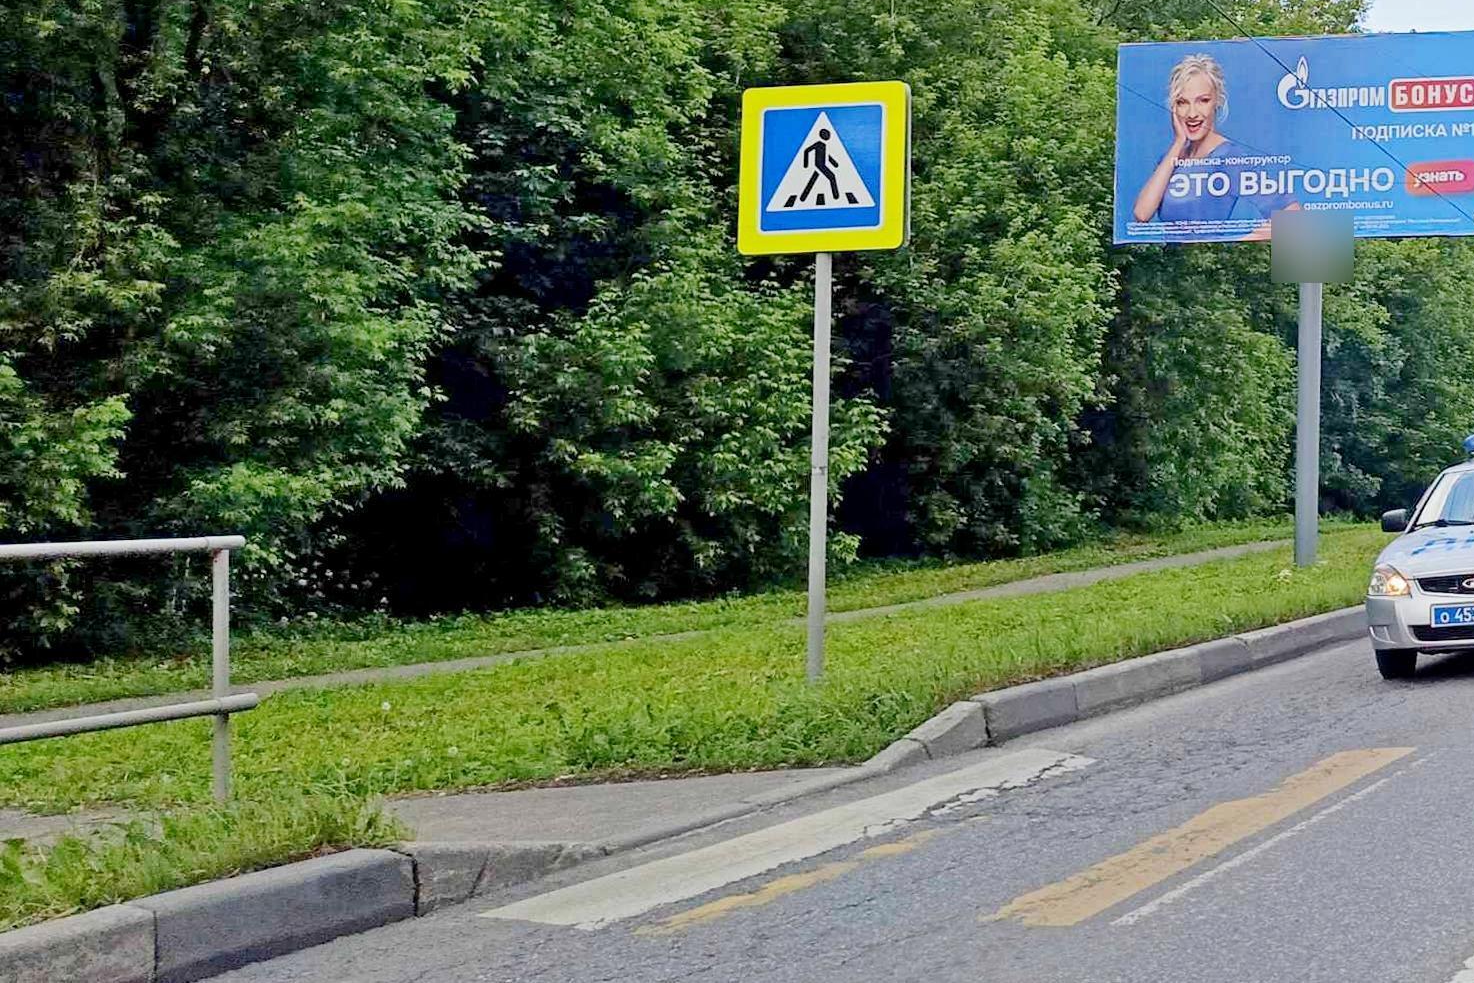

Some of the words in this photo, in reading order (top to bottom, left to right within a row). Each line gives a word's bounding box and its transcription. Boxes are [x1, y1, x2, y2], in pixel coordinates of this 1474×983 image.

[1309, 85, 1385, 109] ГАЗПРОМ
[1394, 83, 1474, 106] БОНУС
[1351, 124, 1448, 141] ПОДПИСКА
[1170, 154, 1292, 168] Подписка-конструктор
[1169, 171, 1231, 198] ЭТО
[1239, 167, 1396, 199] ВЫГОДНО
[1413, 169, 1466, 189] узнать
[1303, 199, 1395, 212] gazprombonus.ru
